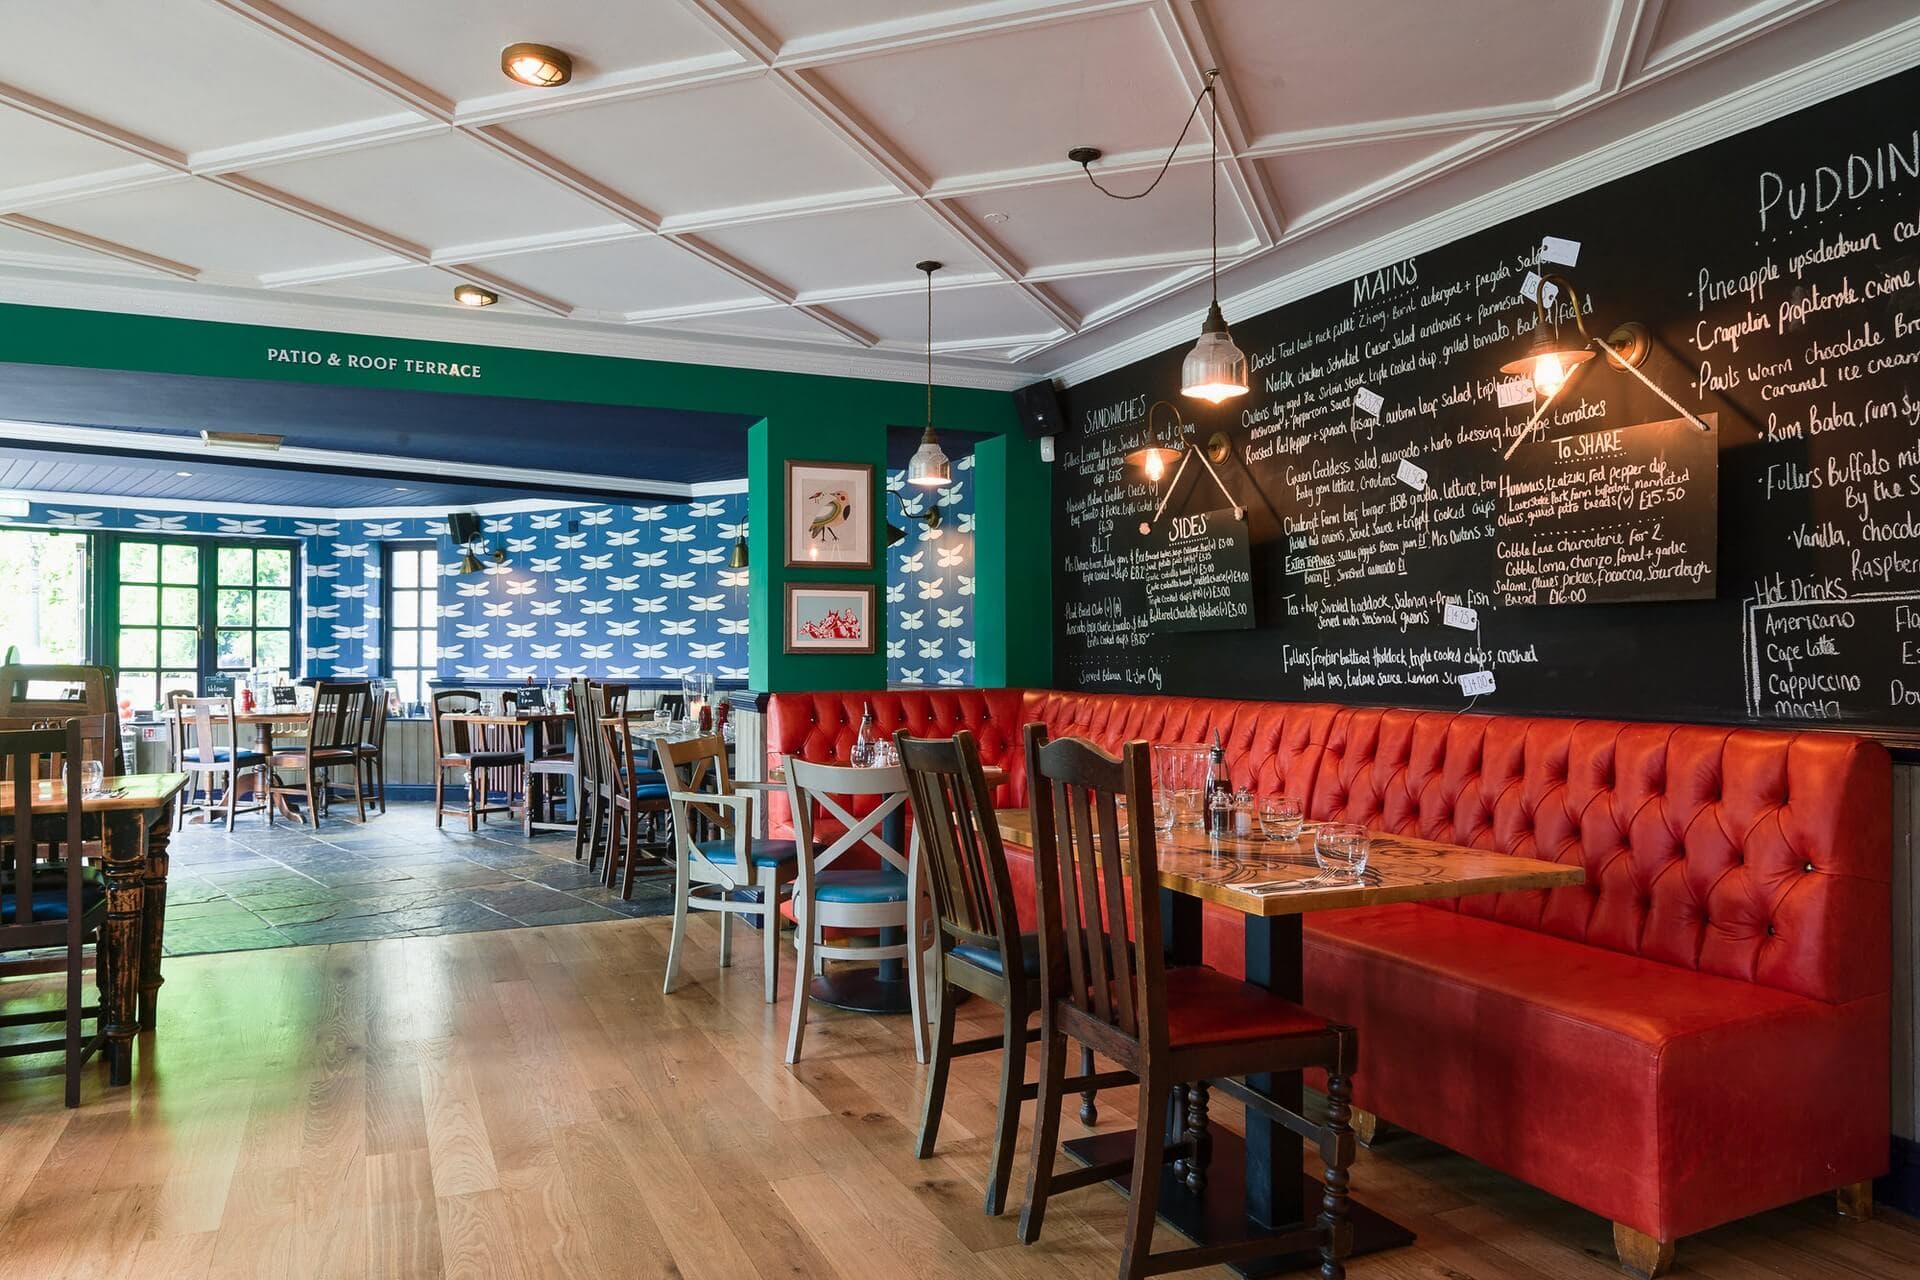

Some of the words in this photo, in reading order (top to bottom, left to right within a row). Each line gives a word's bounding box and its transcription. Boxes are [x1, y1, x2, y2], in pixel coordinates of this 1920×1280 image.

[1353, 257, 1418, 308] MAINS
[1699, 257, 1780, 311] Pineapple
[1789, 232, 1881, 280] upsidedown
[267, 348, 322, 365] PATIO
[327, 353, 342, 367] &
[348, 355, 398, 371] ROOF
[404, 359, 482, 379] TERRACE
[1084, 394, 1146, 434] SANDWICHES
[1574, 430, 1623, 457] SHARE
[1766, 461, 1823, 501] Fullers
[1873, 479, 1905, 501] the
[1639, 486, 1686, 511] £15.50
[1168, 513, 1208, 542] SIDES
[1754, 571, 1787, 606] Hot
[1765, 611, 1856, 637] Americano
[1768, 673, 1862, 700] Cappuccino
